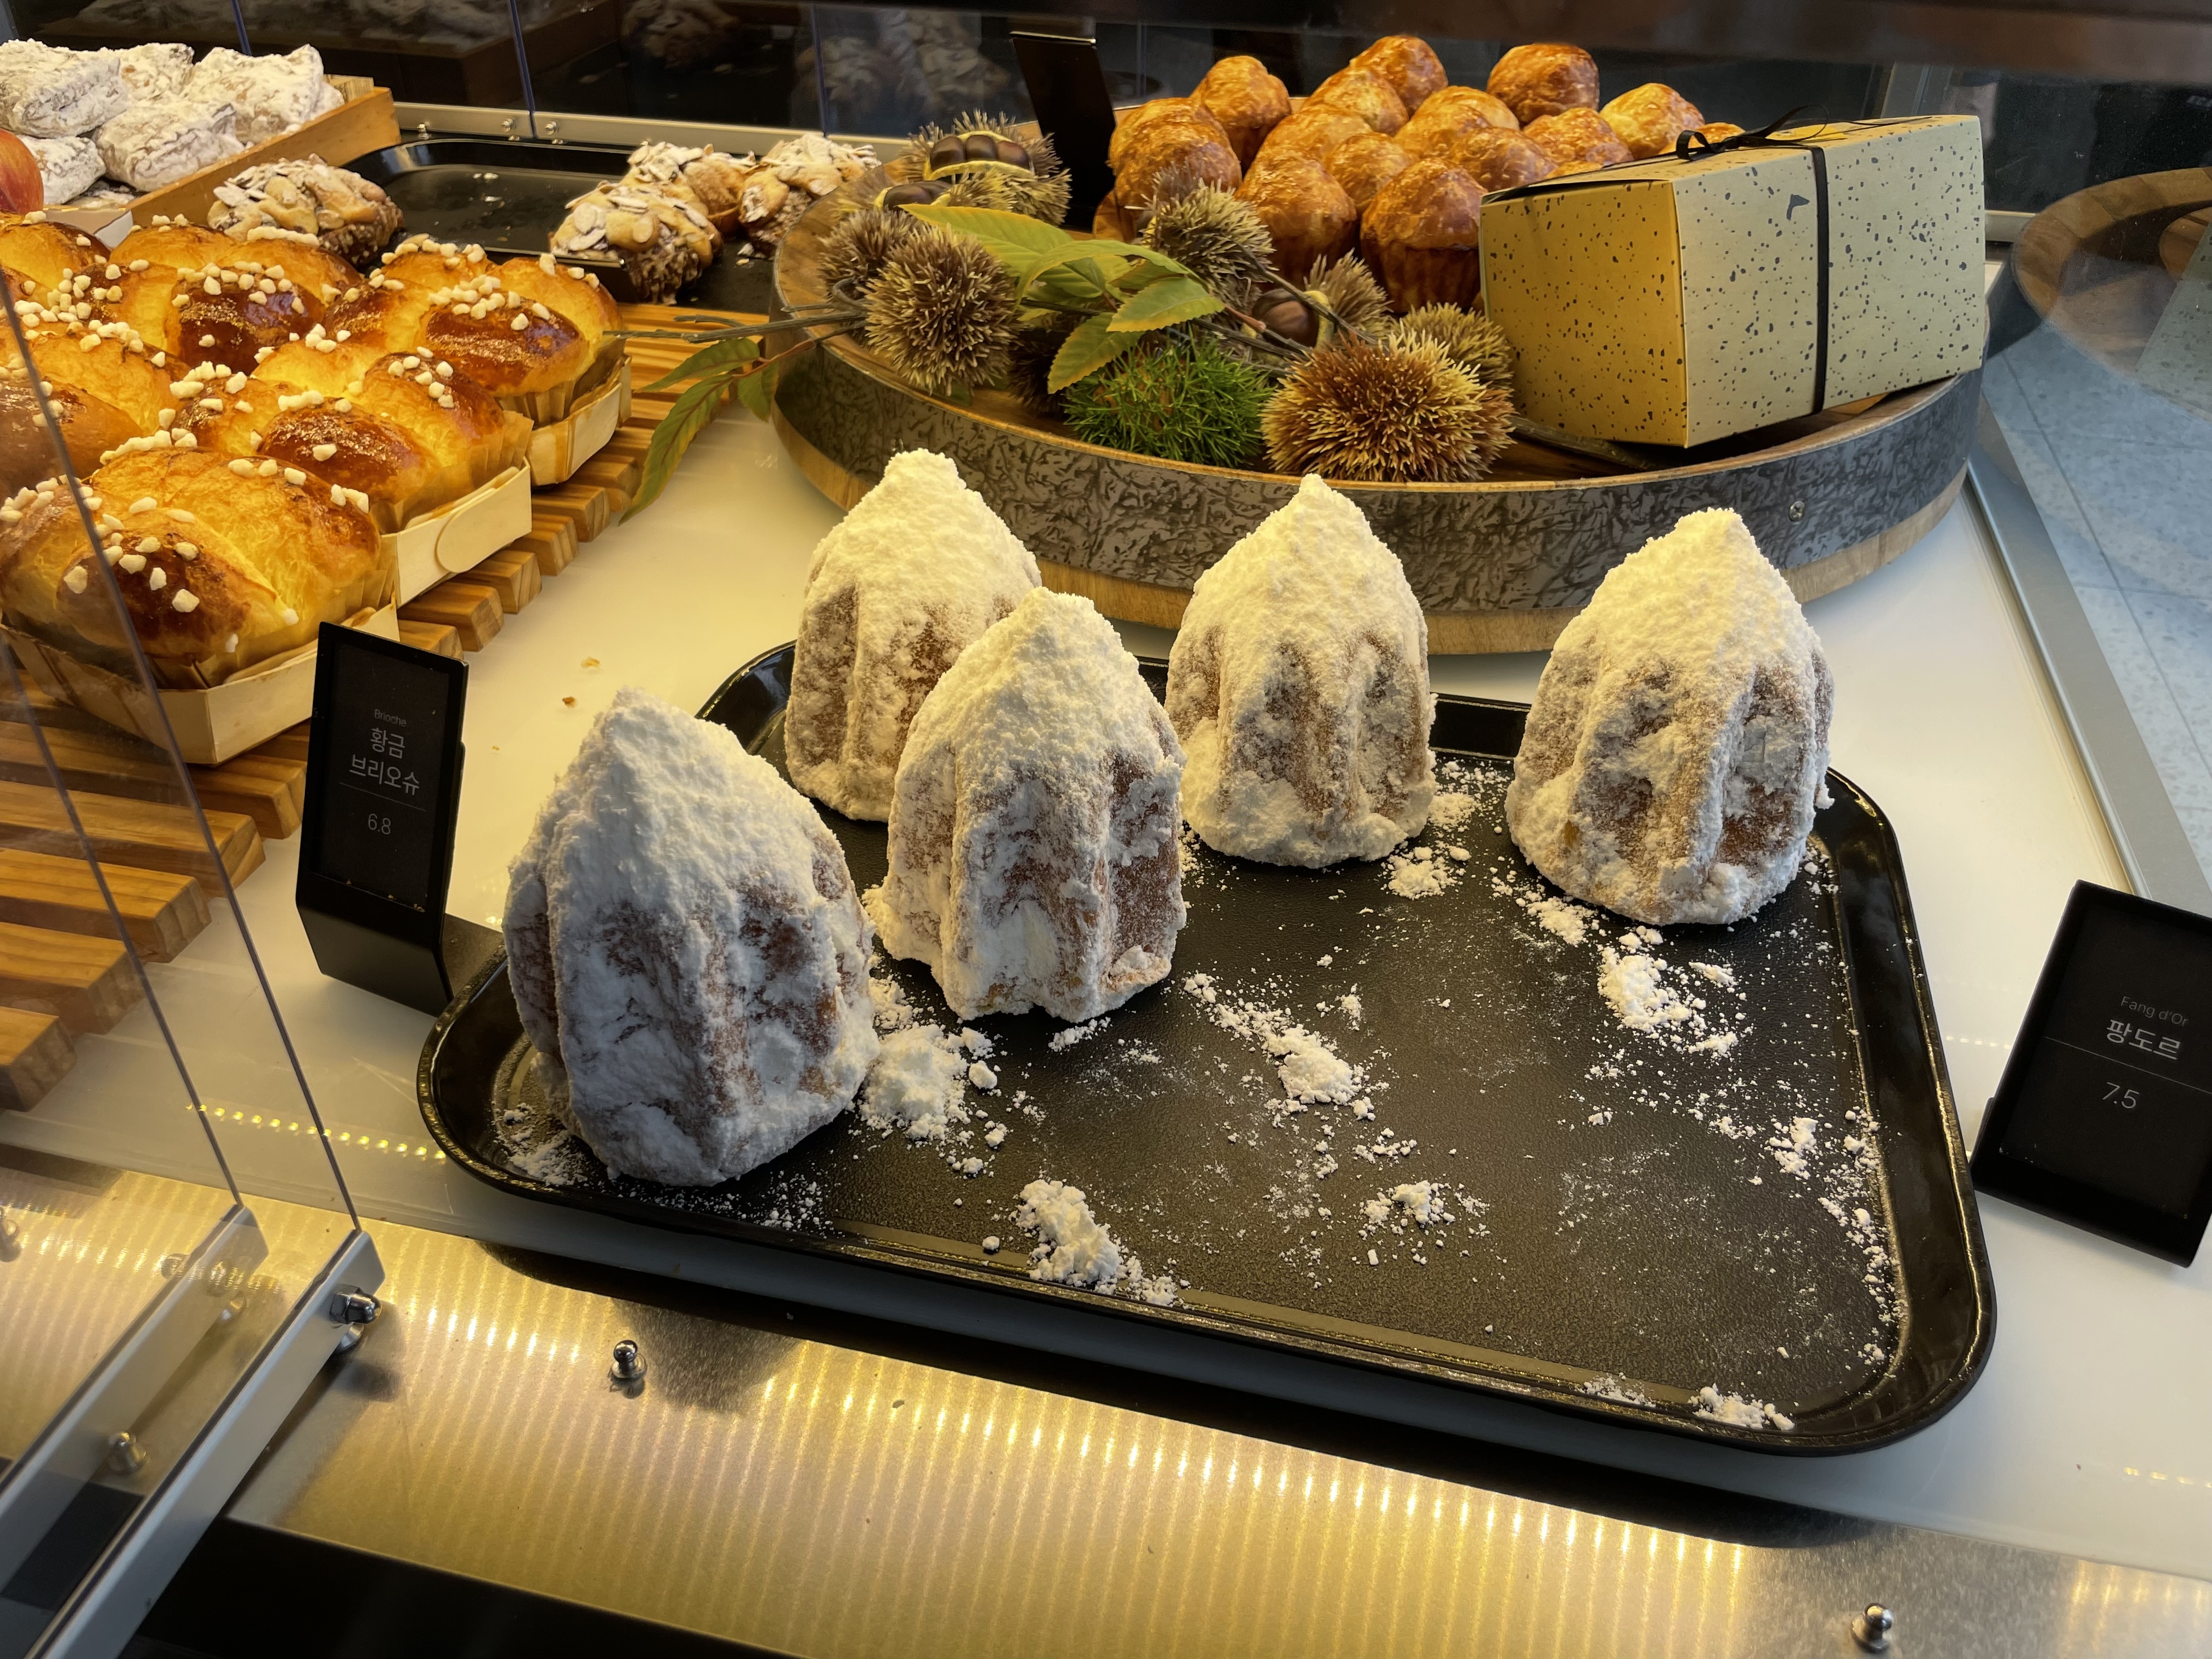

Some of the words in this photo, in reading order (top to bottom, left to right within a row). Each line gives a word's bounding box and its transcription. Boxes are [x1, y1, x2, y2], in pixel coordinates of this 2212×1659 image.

[374, 708, 407, 727] Brioche
[370, 727, 405, 759] 황금
[349, 754, 420, 795] 브리오슈
[368, 813, 391, 834] 6.8
[2120, 996, 2155, 1018] Fang
[2158, 1009, 2190, 1026] d'Or
[2106, 1019, 2181, 1060] 팡도르
[2102, 1081, 2140, 1109] 7.5
